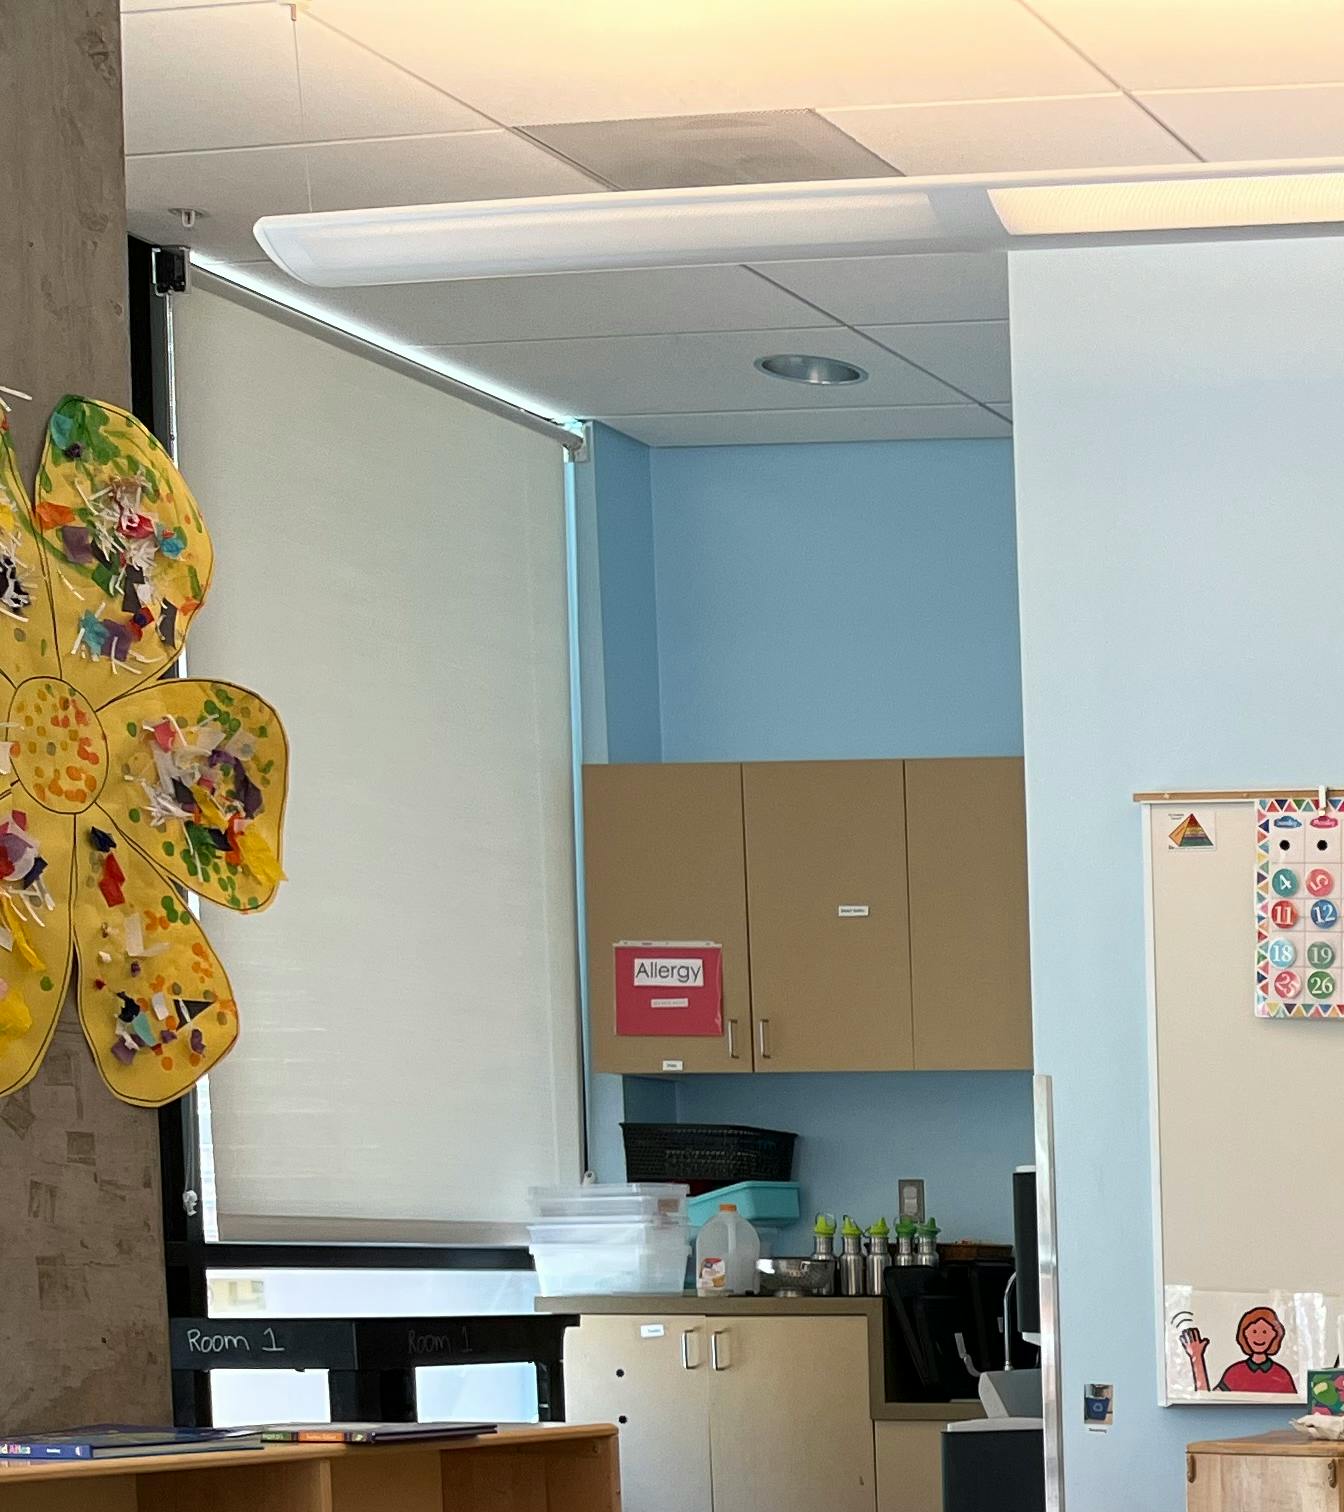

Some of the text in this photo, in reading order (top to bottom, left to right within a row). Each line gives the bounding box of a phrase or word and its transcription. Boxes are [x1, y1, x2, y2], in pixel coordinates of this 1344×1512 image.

[1279, 873, 1292, 890] 4
[1309, 873, 1330, 890] 5
[1275, 907, 1295, 925] 11
[1314, 905, 1335, 923] 12
[1272, 943, 1293, 962] 18
[1311, 947, 1332, 965] 19
[635, 962, 702, 983] Allergy
[1275, 976, 1299, 997] 25
[1310, 976, 1333, 994] 26
[187, 1327, 285, 1353] Room 1
